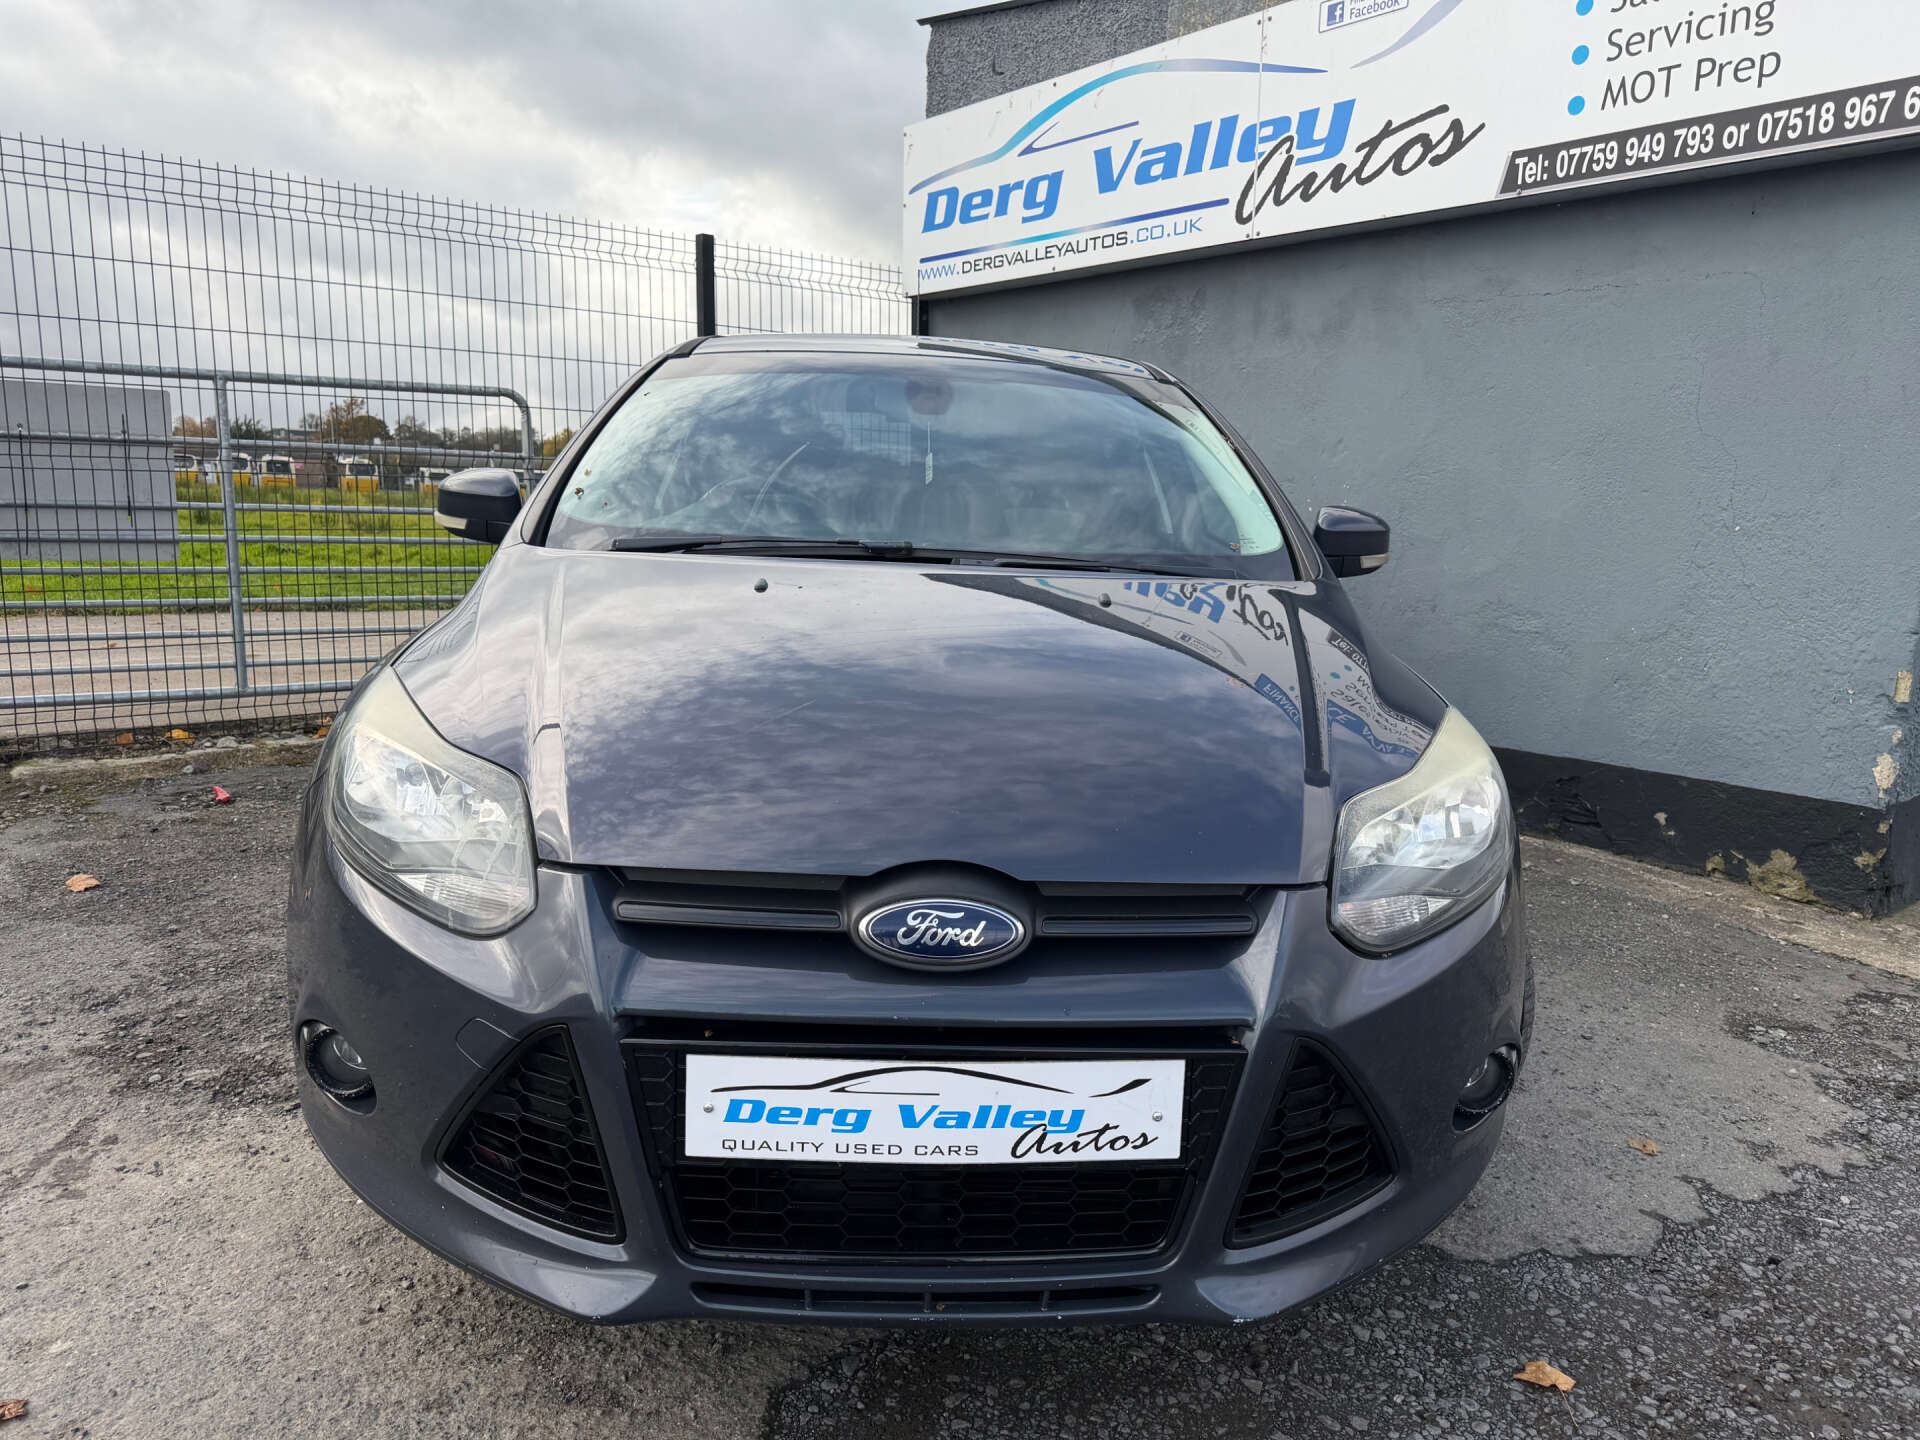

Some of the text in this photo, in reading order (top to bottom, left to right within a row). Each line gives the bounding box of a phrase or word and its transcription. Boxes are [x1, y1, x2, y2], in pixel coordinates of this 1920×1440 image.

[1606, 0, 1776, 62] Servicing
[1600, 50, 1782, 110] MOT Prep
[922, 98, 1357, 234] Derg Valley
[1235, 103, 1486, 225] Autos
[1515, 154, 1549, 184] Tel:
[1555, 140, 1617, 178] 07759
[1624, 131, 1665, 165] 949
[1673, 123, 1714, 158] 793
[1723, 122, 1750, 149] or
[1757, 102, 1836, 145] 07518
[1844, 91, 1896, 130] 967
[918, 216, 1203, 281] WWW.DERGVALLEYAUTOS.CO.UK
[897, 909, 987, 947] Ford
[723, 1098, 1085, 1134] Derg Valley
[1010, 1122, 1159, 1160] Autos
[721, 1138, 979, 1157] QUALITY USED CARS
